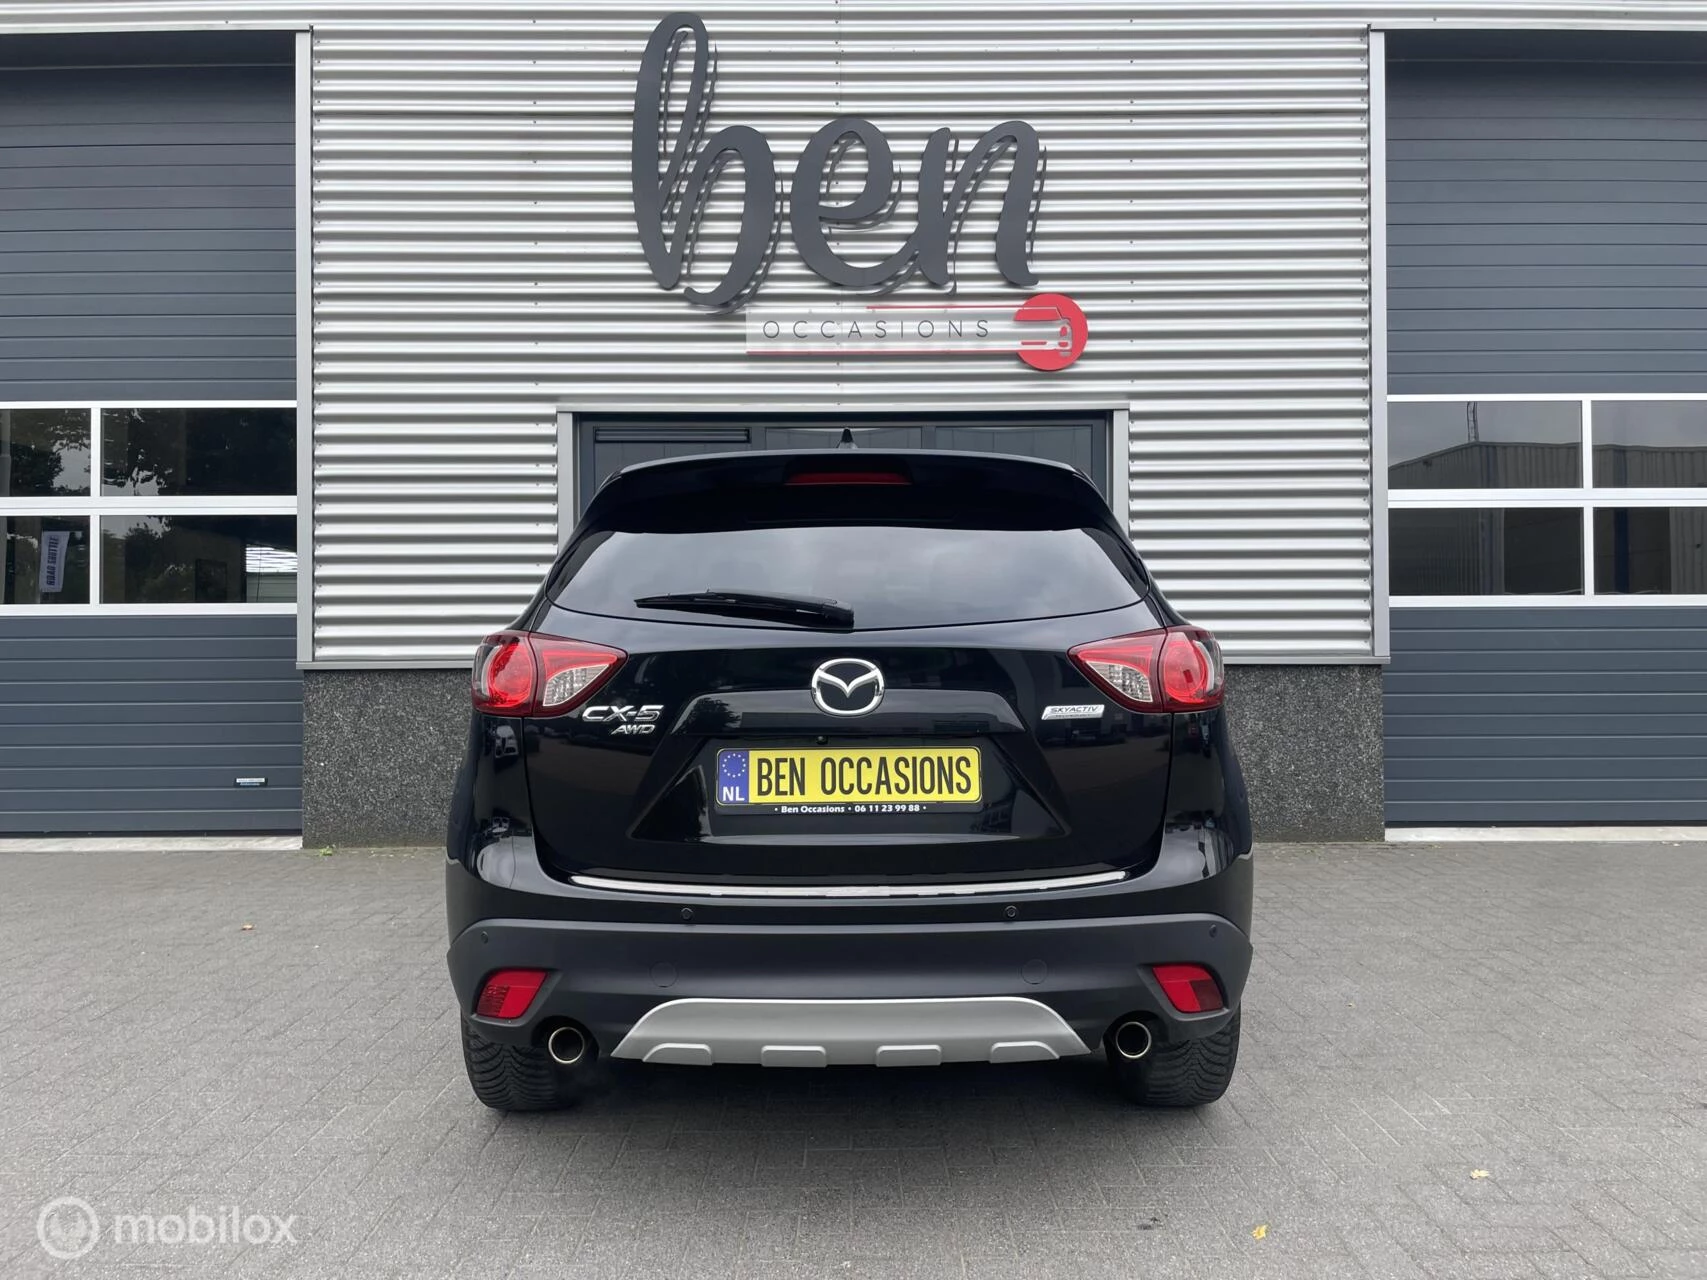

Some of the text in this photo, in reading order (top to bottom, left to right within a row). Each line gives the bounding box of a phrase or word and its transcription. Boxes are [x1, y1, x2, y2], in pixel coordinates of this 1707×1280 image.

[631, 11, 1040, 306] ben
[762, 319, 990, 339] OCCASIONS
[582, 704, 664, 722] CX-5
[1050, 705, 1099, 714] SKYACTIV
[610, 724, 656, 735] AWD
[756, 756, 972, 797] BEN OCCASIONS
[722, 786, 745, 801] NL
[781, 804, 920, 813] Ben Occasions 06 11 23 99 88
